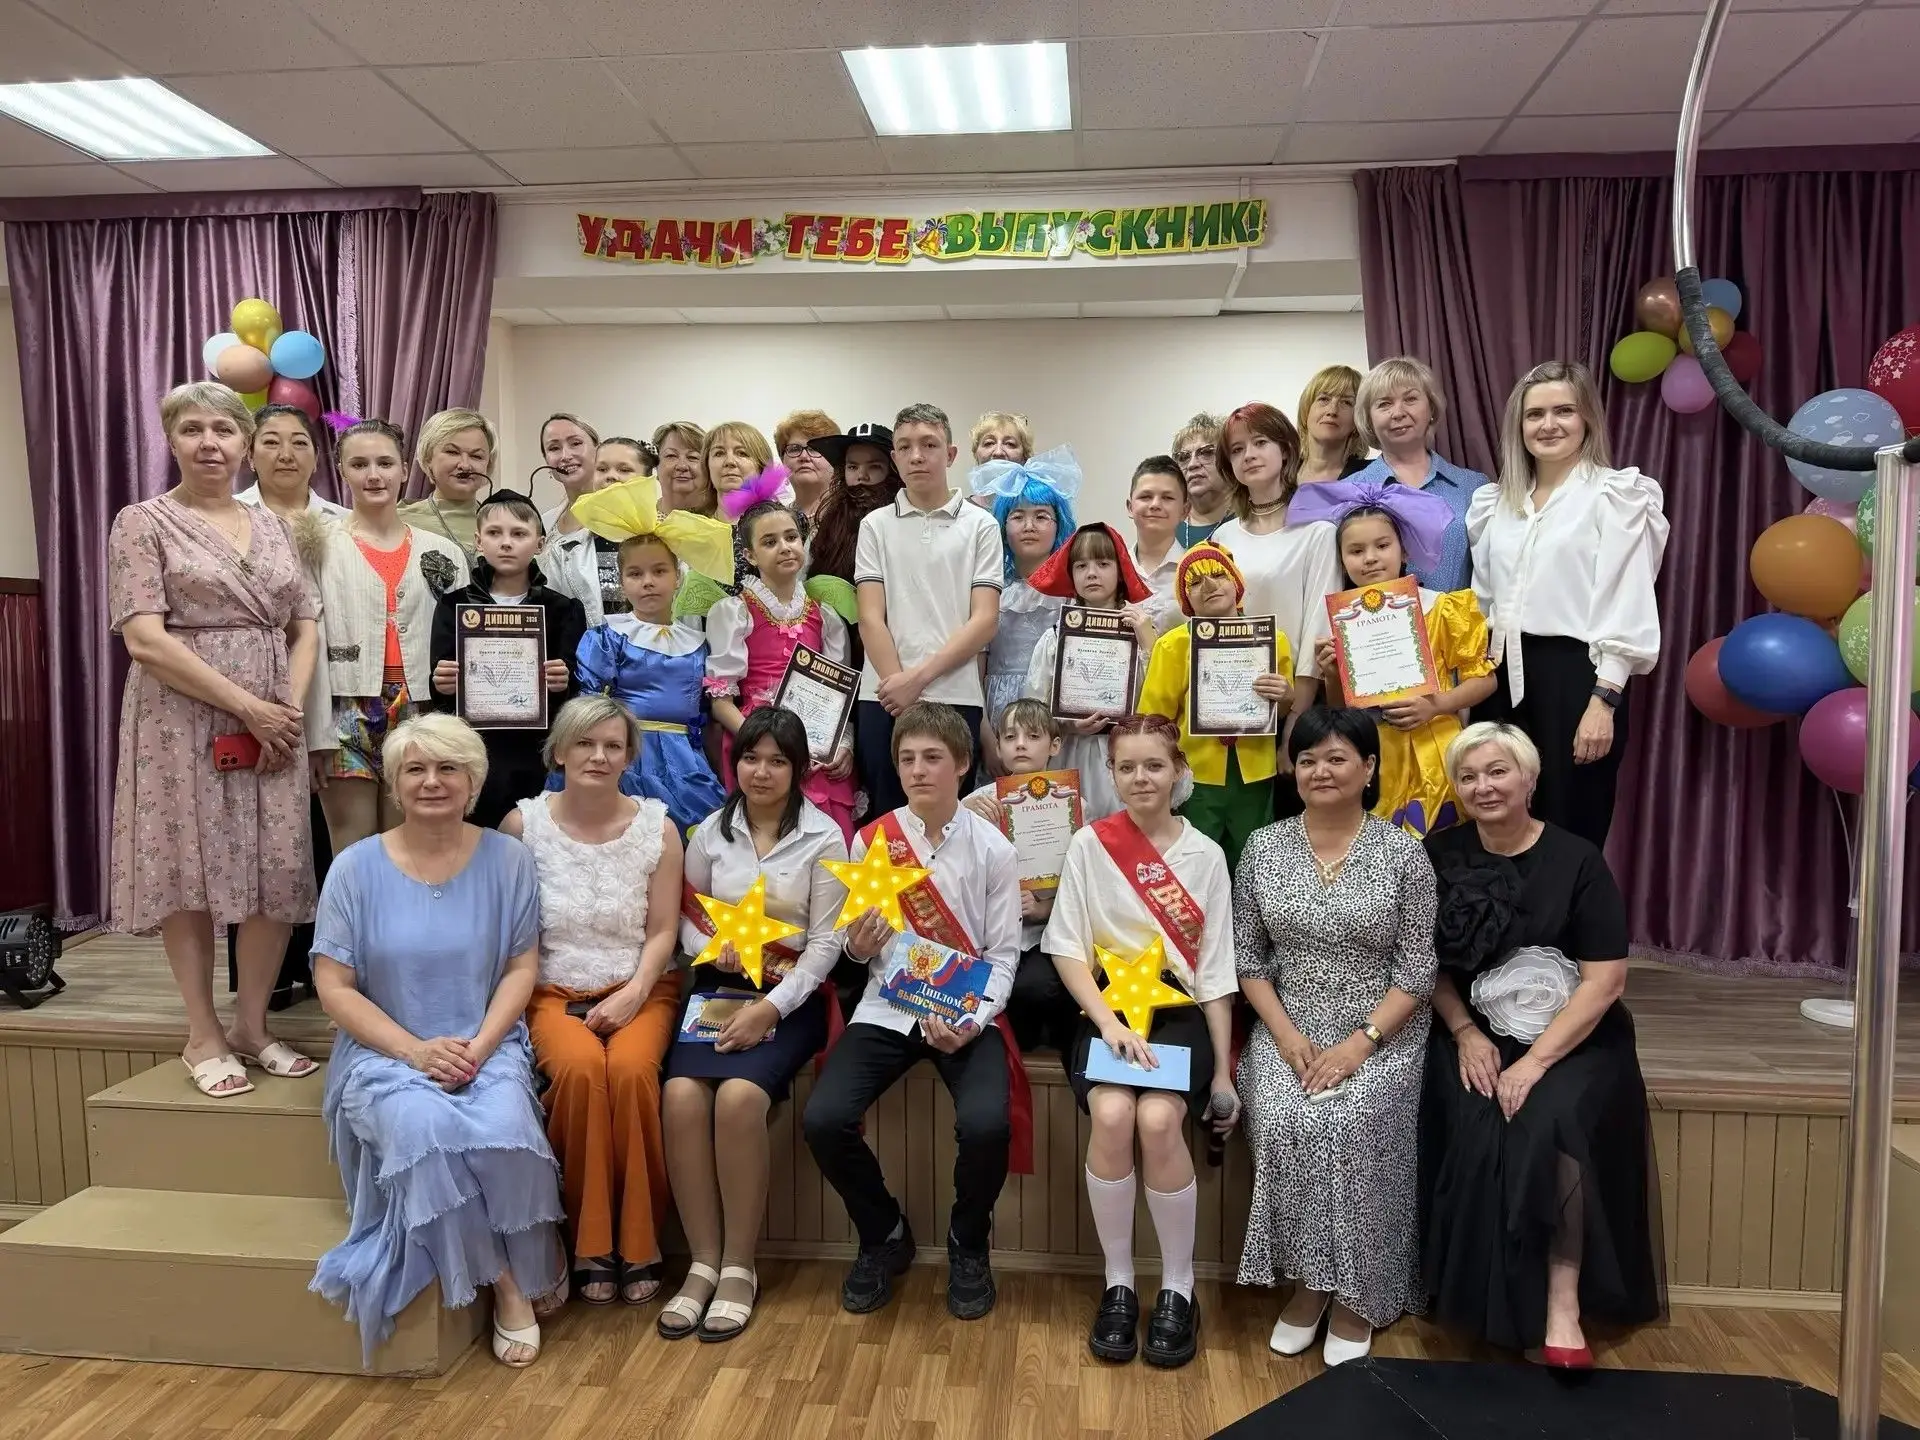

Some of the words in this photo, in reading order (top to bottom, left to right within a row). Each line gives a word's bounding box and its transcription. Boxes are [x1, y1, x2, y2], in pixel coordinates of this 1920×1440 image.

[577, 213, 753, 263] УДАЧИ
[785, 214, 910, 260] ТЕБЕ,
[945, 199, 1264, 256] ВЫПУСКНИК!
[484, 613, 522, 626] ДИПЛОМ
[1085, 616, 1119, 629] ДИПЛОМ
[1356, 613, 1398, 628] ГРАМОТА
[1218, 624, 1254, 638] ДИПЛОМ
[810, 659, 841, 681] ДИПЛОМ
[1021, 802, 1059, 813] ГРАМОТА
[915, 981, 962, 1009] Диплом
[896, 988, 959, 1020] ВЫПУСКНИКА
